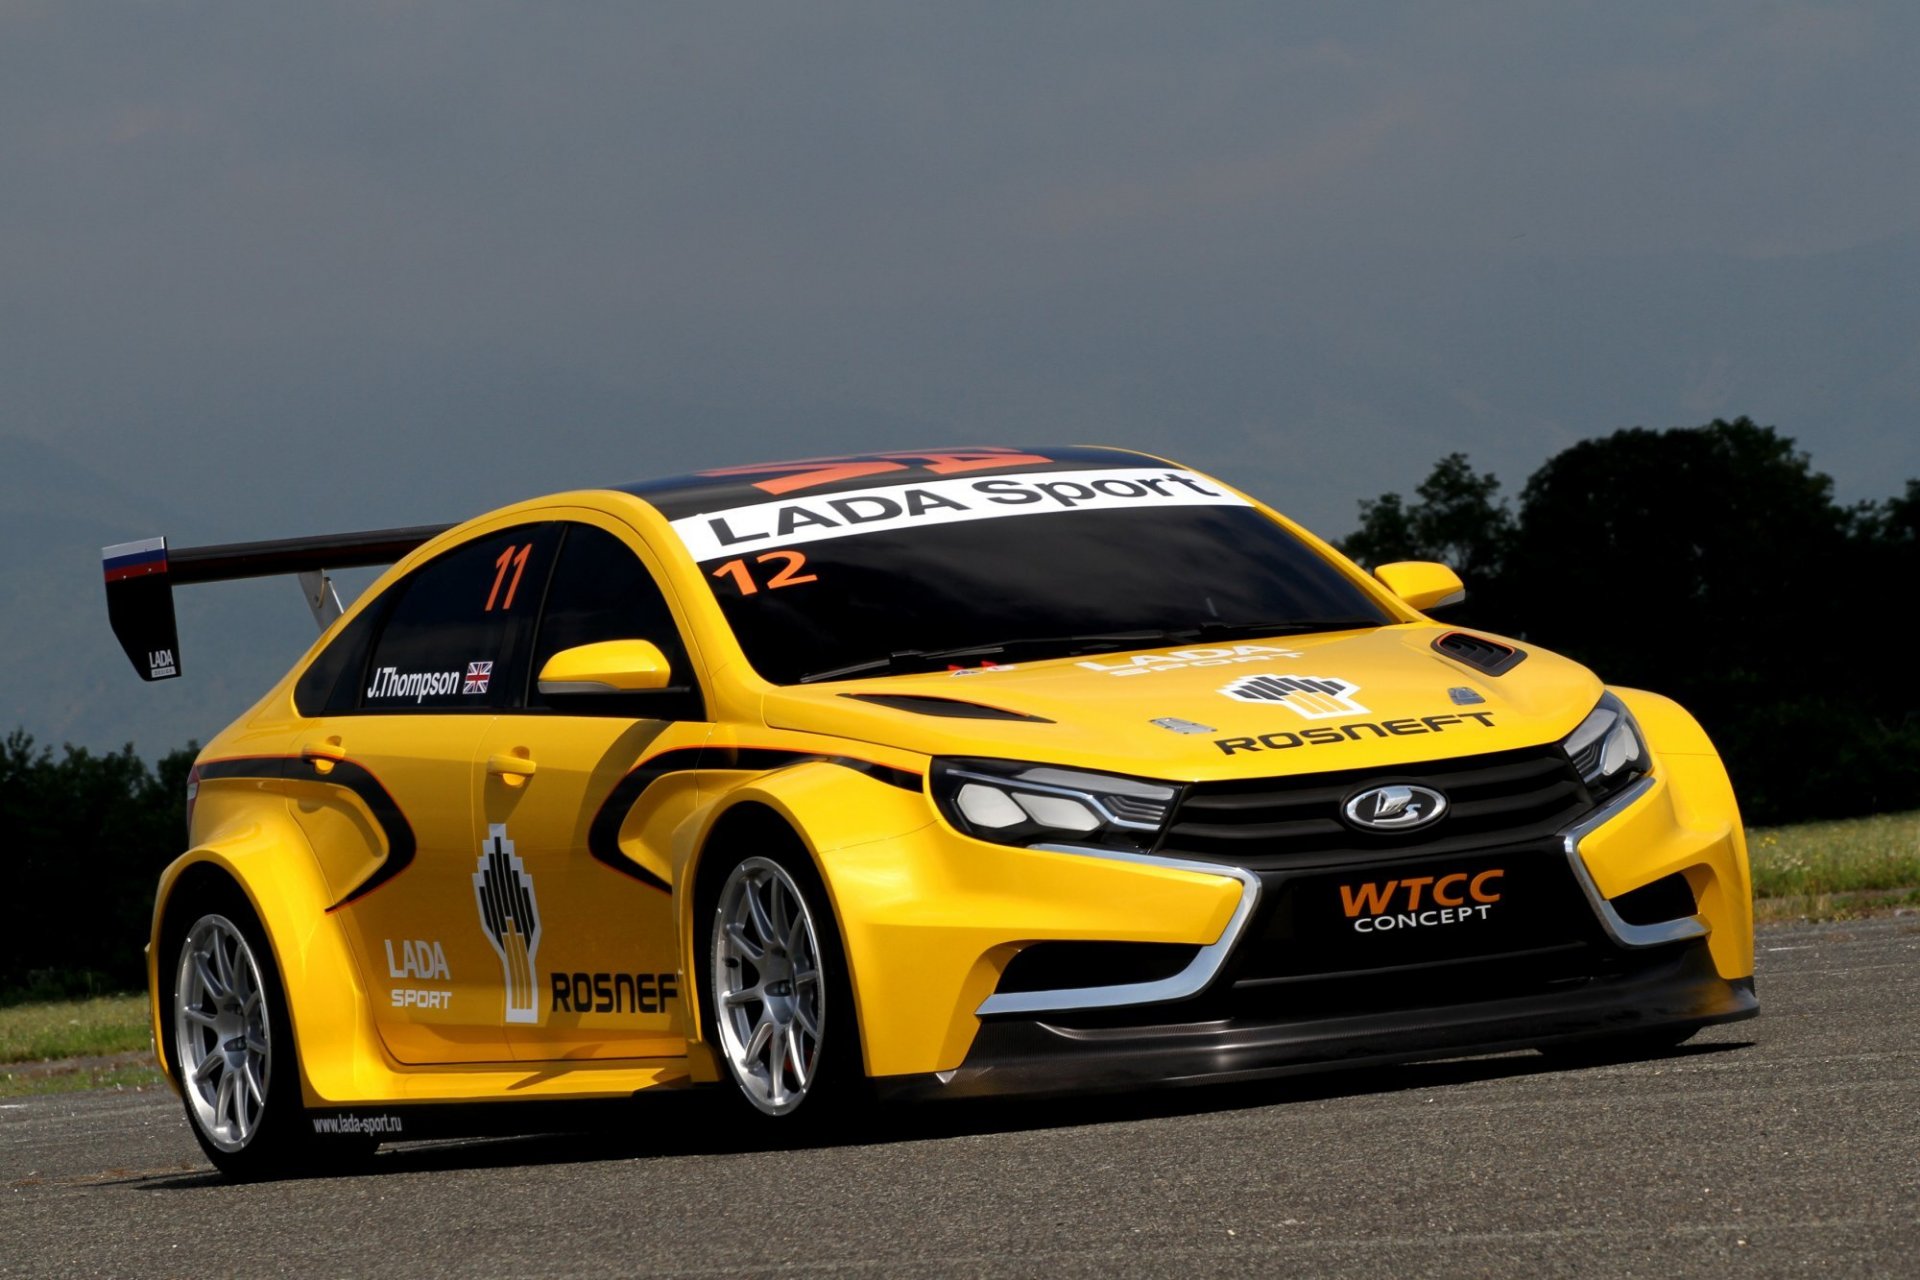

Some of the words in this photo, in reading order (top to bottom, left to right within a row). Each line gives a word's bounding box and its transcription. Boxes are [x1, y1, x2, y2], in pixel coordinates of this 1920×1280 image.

[708, 489, 972, 546] LADA
[971, 474, 1221, 507] Sport
[485, 543, 532, 611] 11
[712, 551, 817, 597] 12
[149, 649, 174, 668] LADA
[1074, 645, 1296, 672] LADA
[1109, 651, 1305, 677] SPORT
[367, 667, 460, 703] J.Thompson
[1213, 711, 1494, 755] ROSNEFT
[1340, 869, 1504, 917] WTCC
[1354, 905, 1492, 932] CONCEPT
[384, 939, 451, 980] LADA
[391, 989, 452, 1009] SPORT
[550, 972, 680, 1013] ROSNEF
[313, 1113, 403, 1136] www.lada-sport.ru
